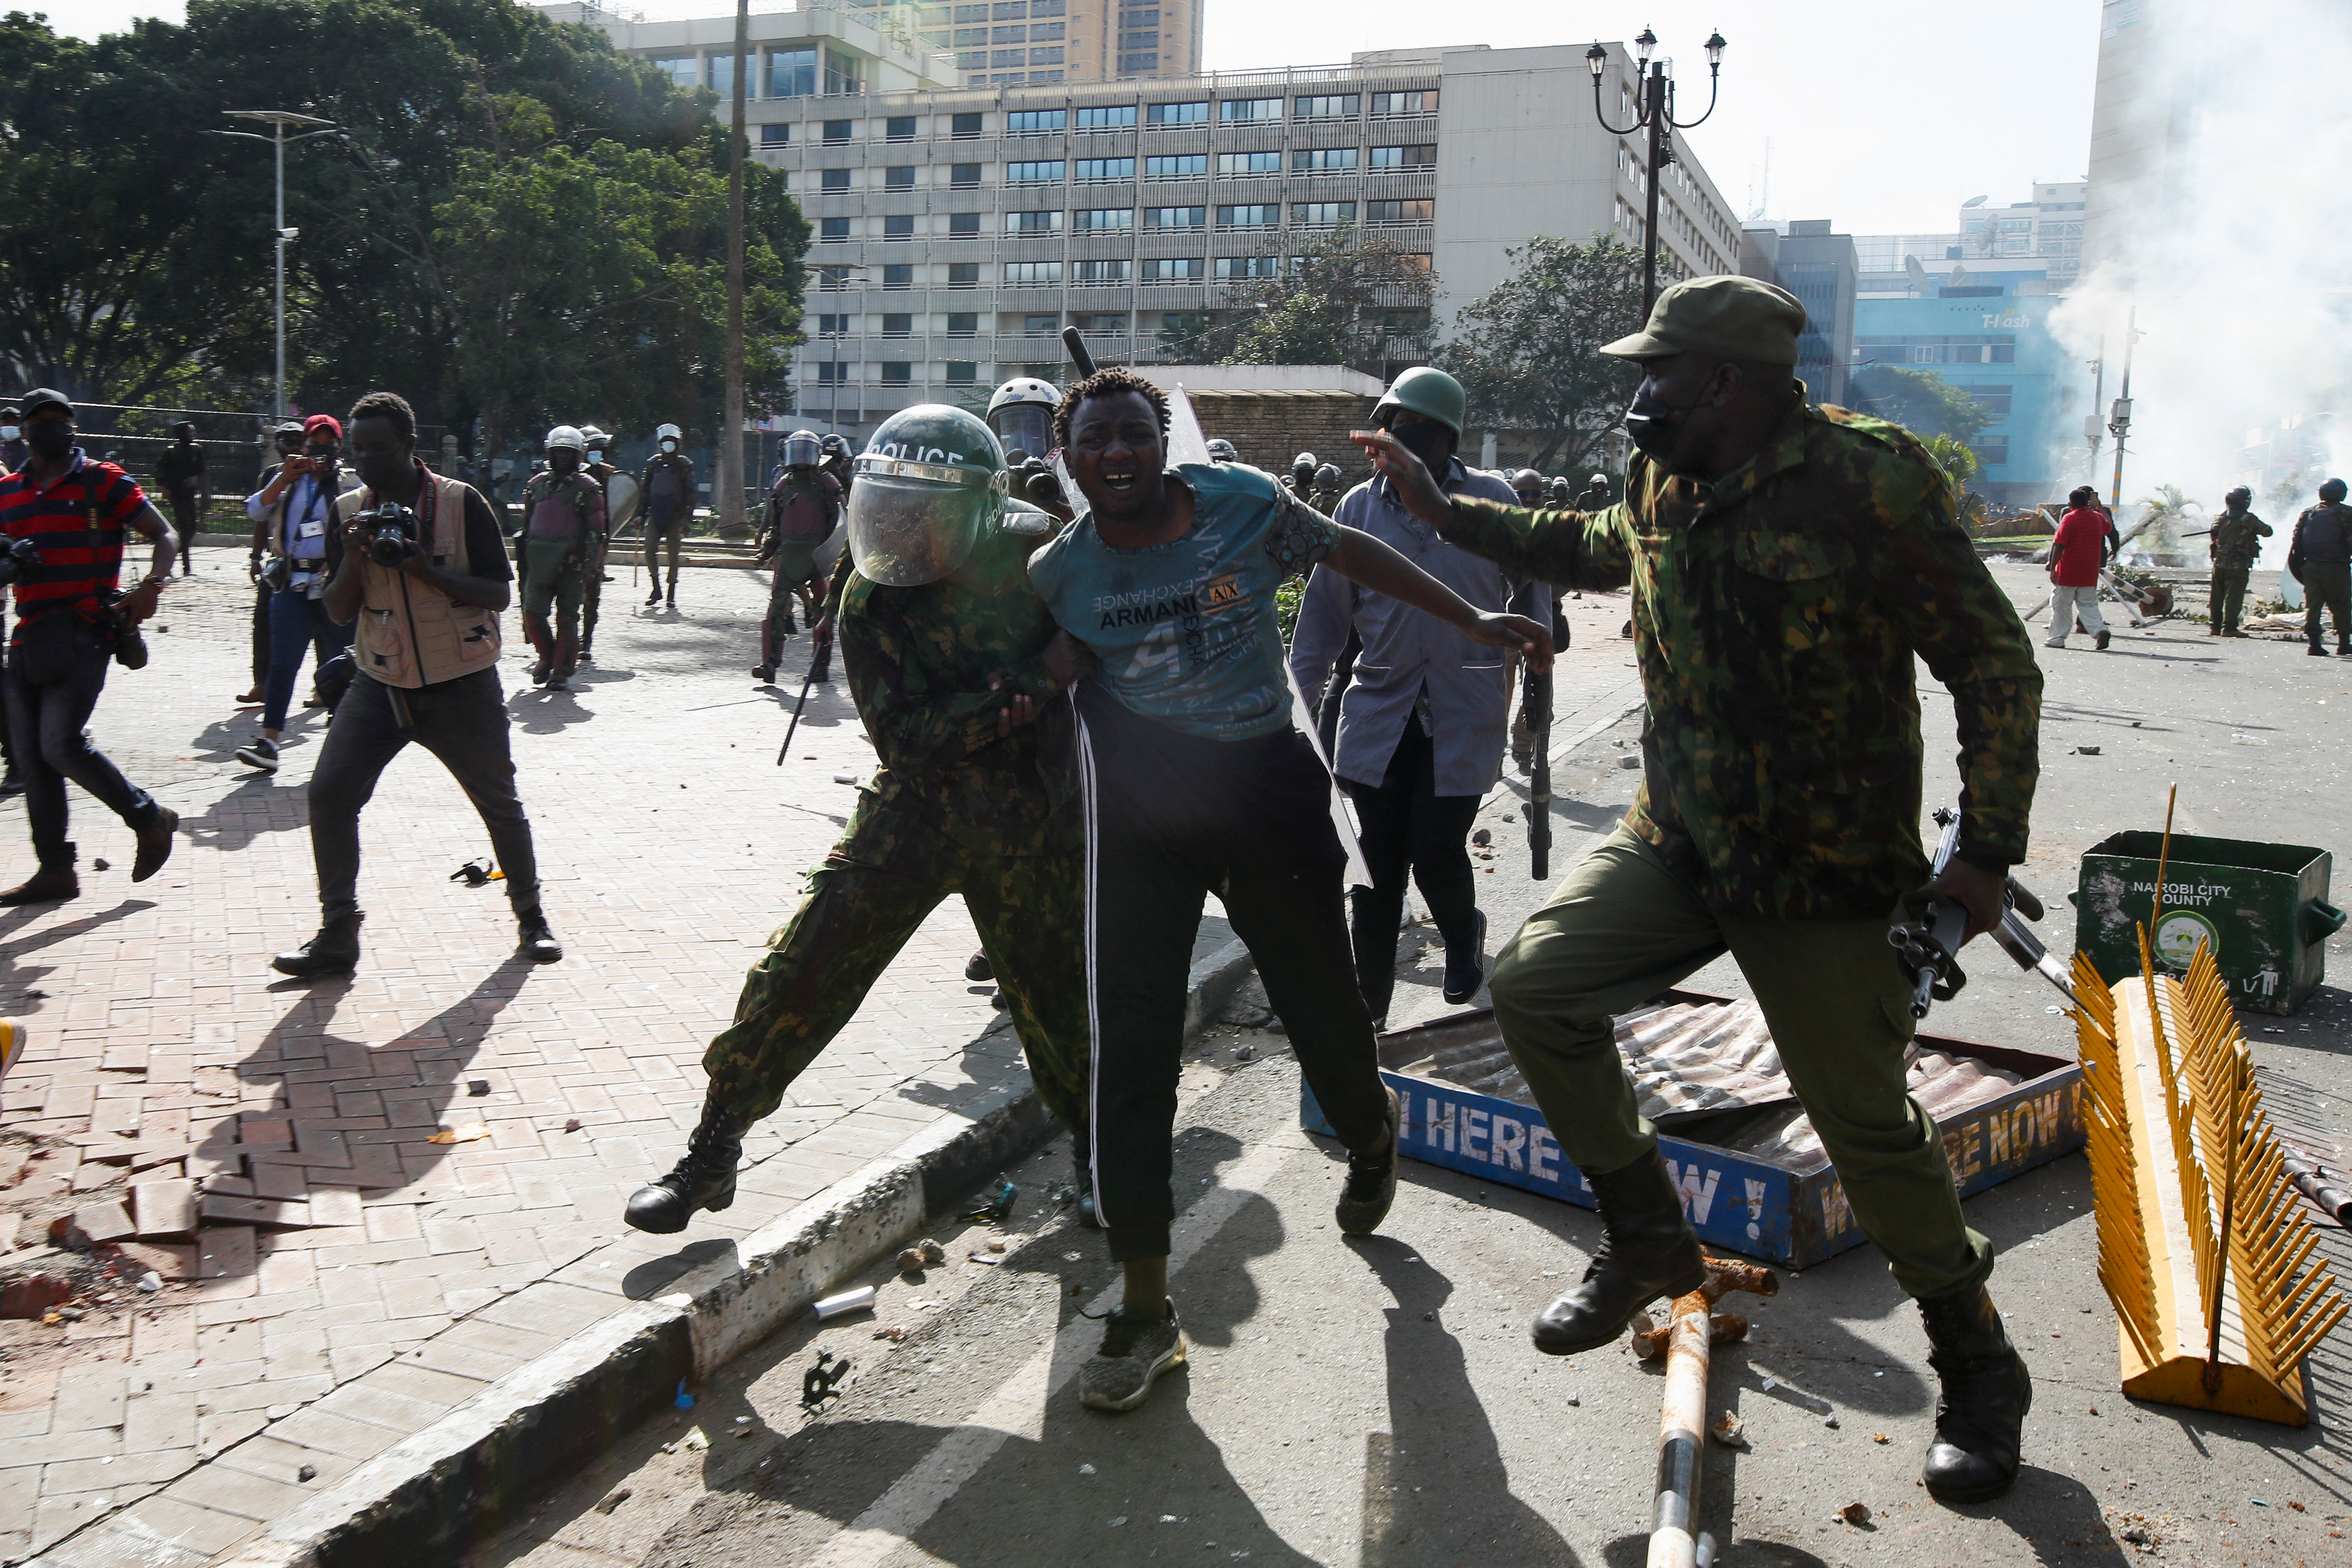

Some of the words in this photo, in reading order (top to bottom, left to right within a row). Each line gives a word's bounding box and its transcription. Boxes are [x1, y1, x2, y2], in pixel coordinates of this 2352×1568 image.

[1092, 579, 1194, 613] EXCHANGE
[1100, 596, 1197, 630] ARMANI
[2134, 882, 2194, 894] NAIROBI
[2198, 885, 2231, 896] CITY
[2152, 893, 2213, 907] COUNTY
[1426, 1097, 1560, 1183] HERE
[1990, 1090, 2061, 1166] NOW
